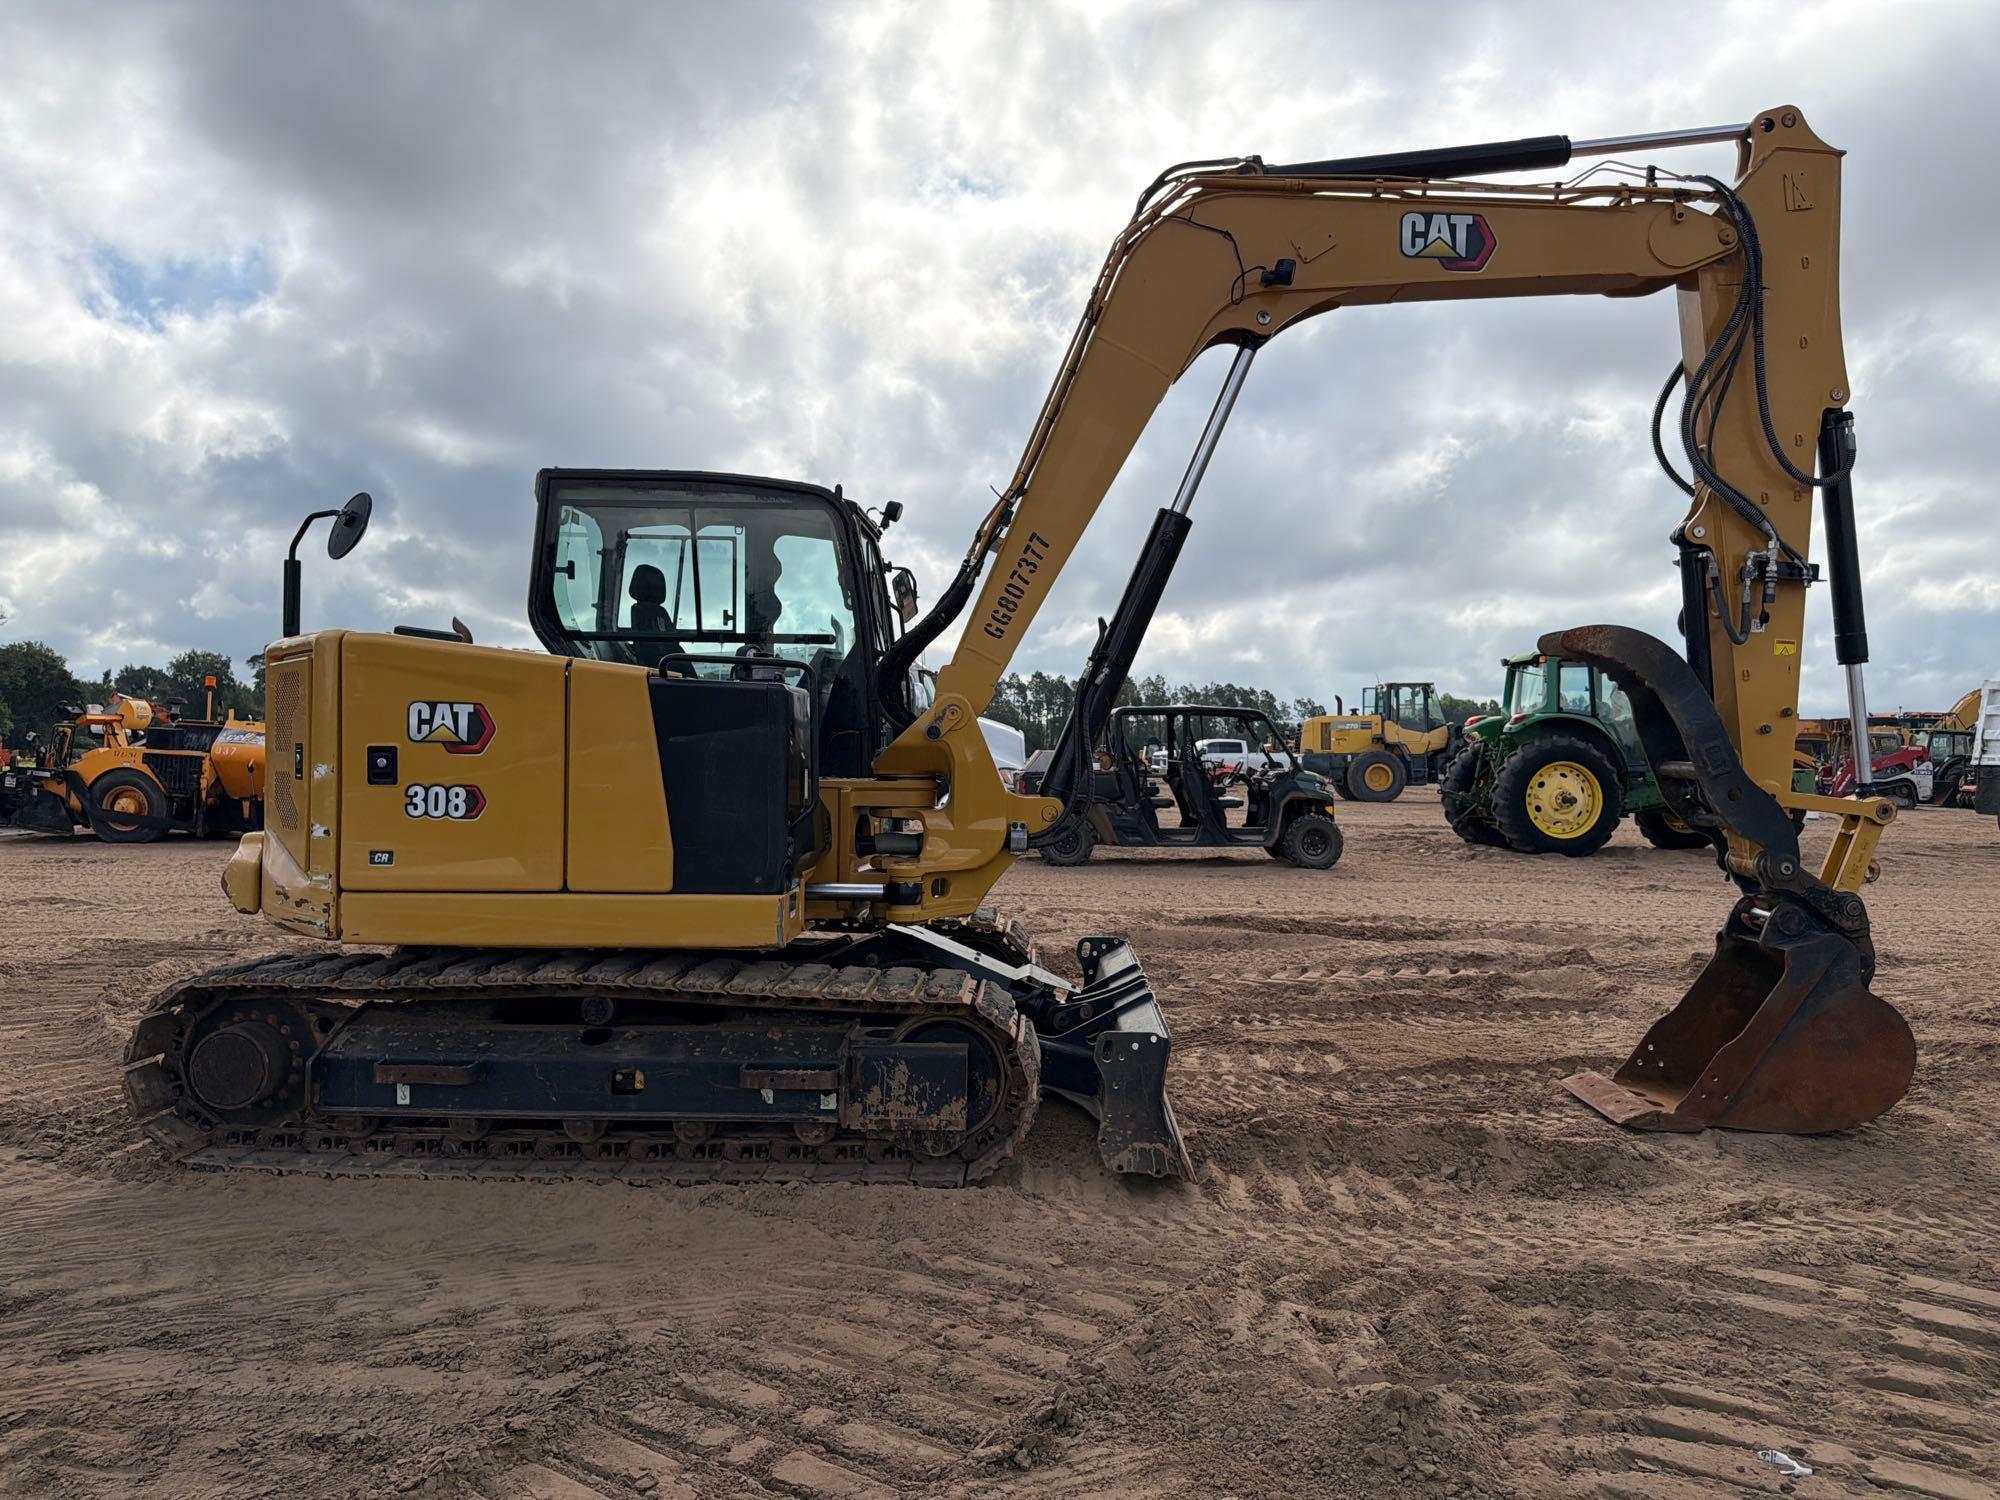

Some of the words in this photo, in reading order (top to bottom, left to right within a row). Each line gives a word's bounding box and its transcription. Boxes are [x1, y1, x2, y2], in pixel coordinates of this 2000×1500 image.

[1402, 213, 1473, 257] CAT
[984, 532, 1050, 639] GG807377
[409, 702, 474, 742] CAT
[407, 785, 467, 818] 308
[375, 852, 389, 863] CR
